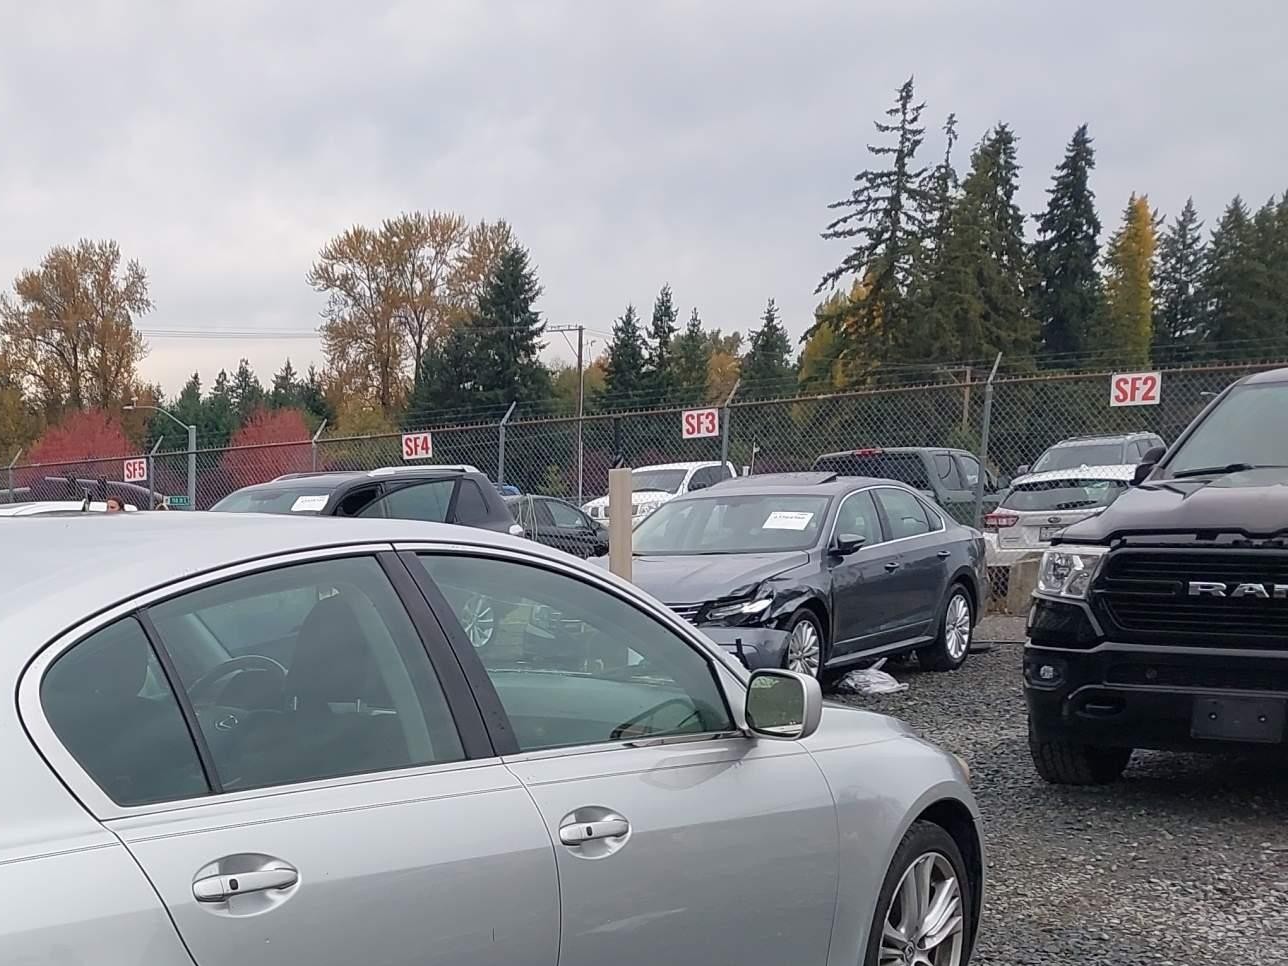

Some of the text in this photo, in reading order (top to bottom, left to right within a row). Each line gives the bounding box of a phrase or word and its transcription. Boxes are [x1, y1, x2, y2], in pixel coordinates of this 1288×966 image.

[1114, 375, 1157, 403] SF2
[685, 411, 716, 435] SF3
[404, 435, 430, 457] SF4
[126, 461, 145, 480] SF5
